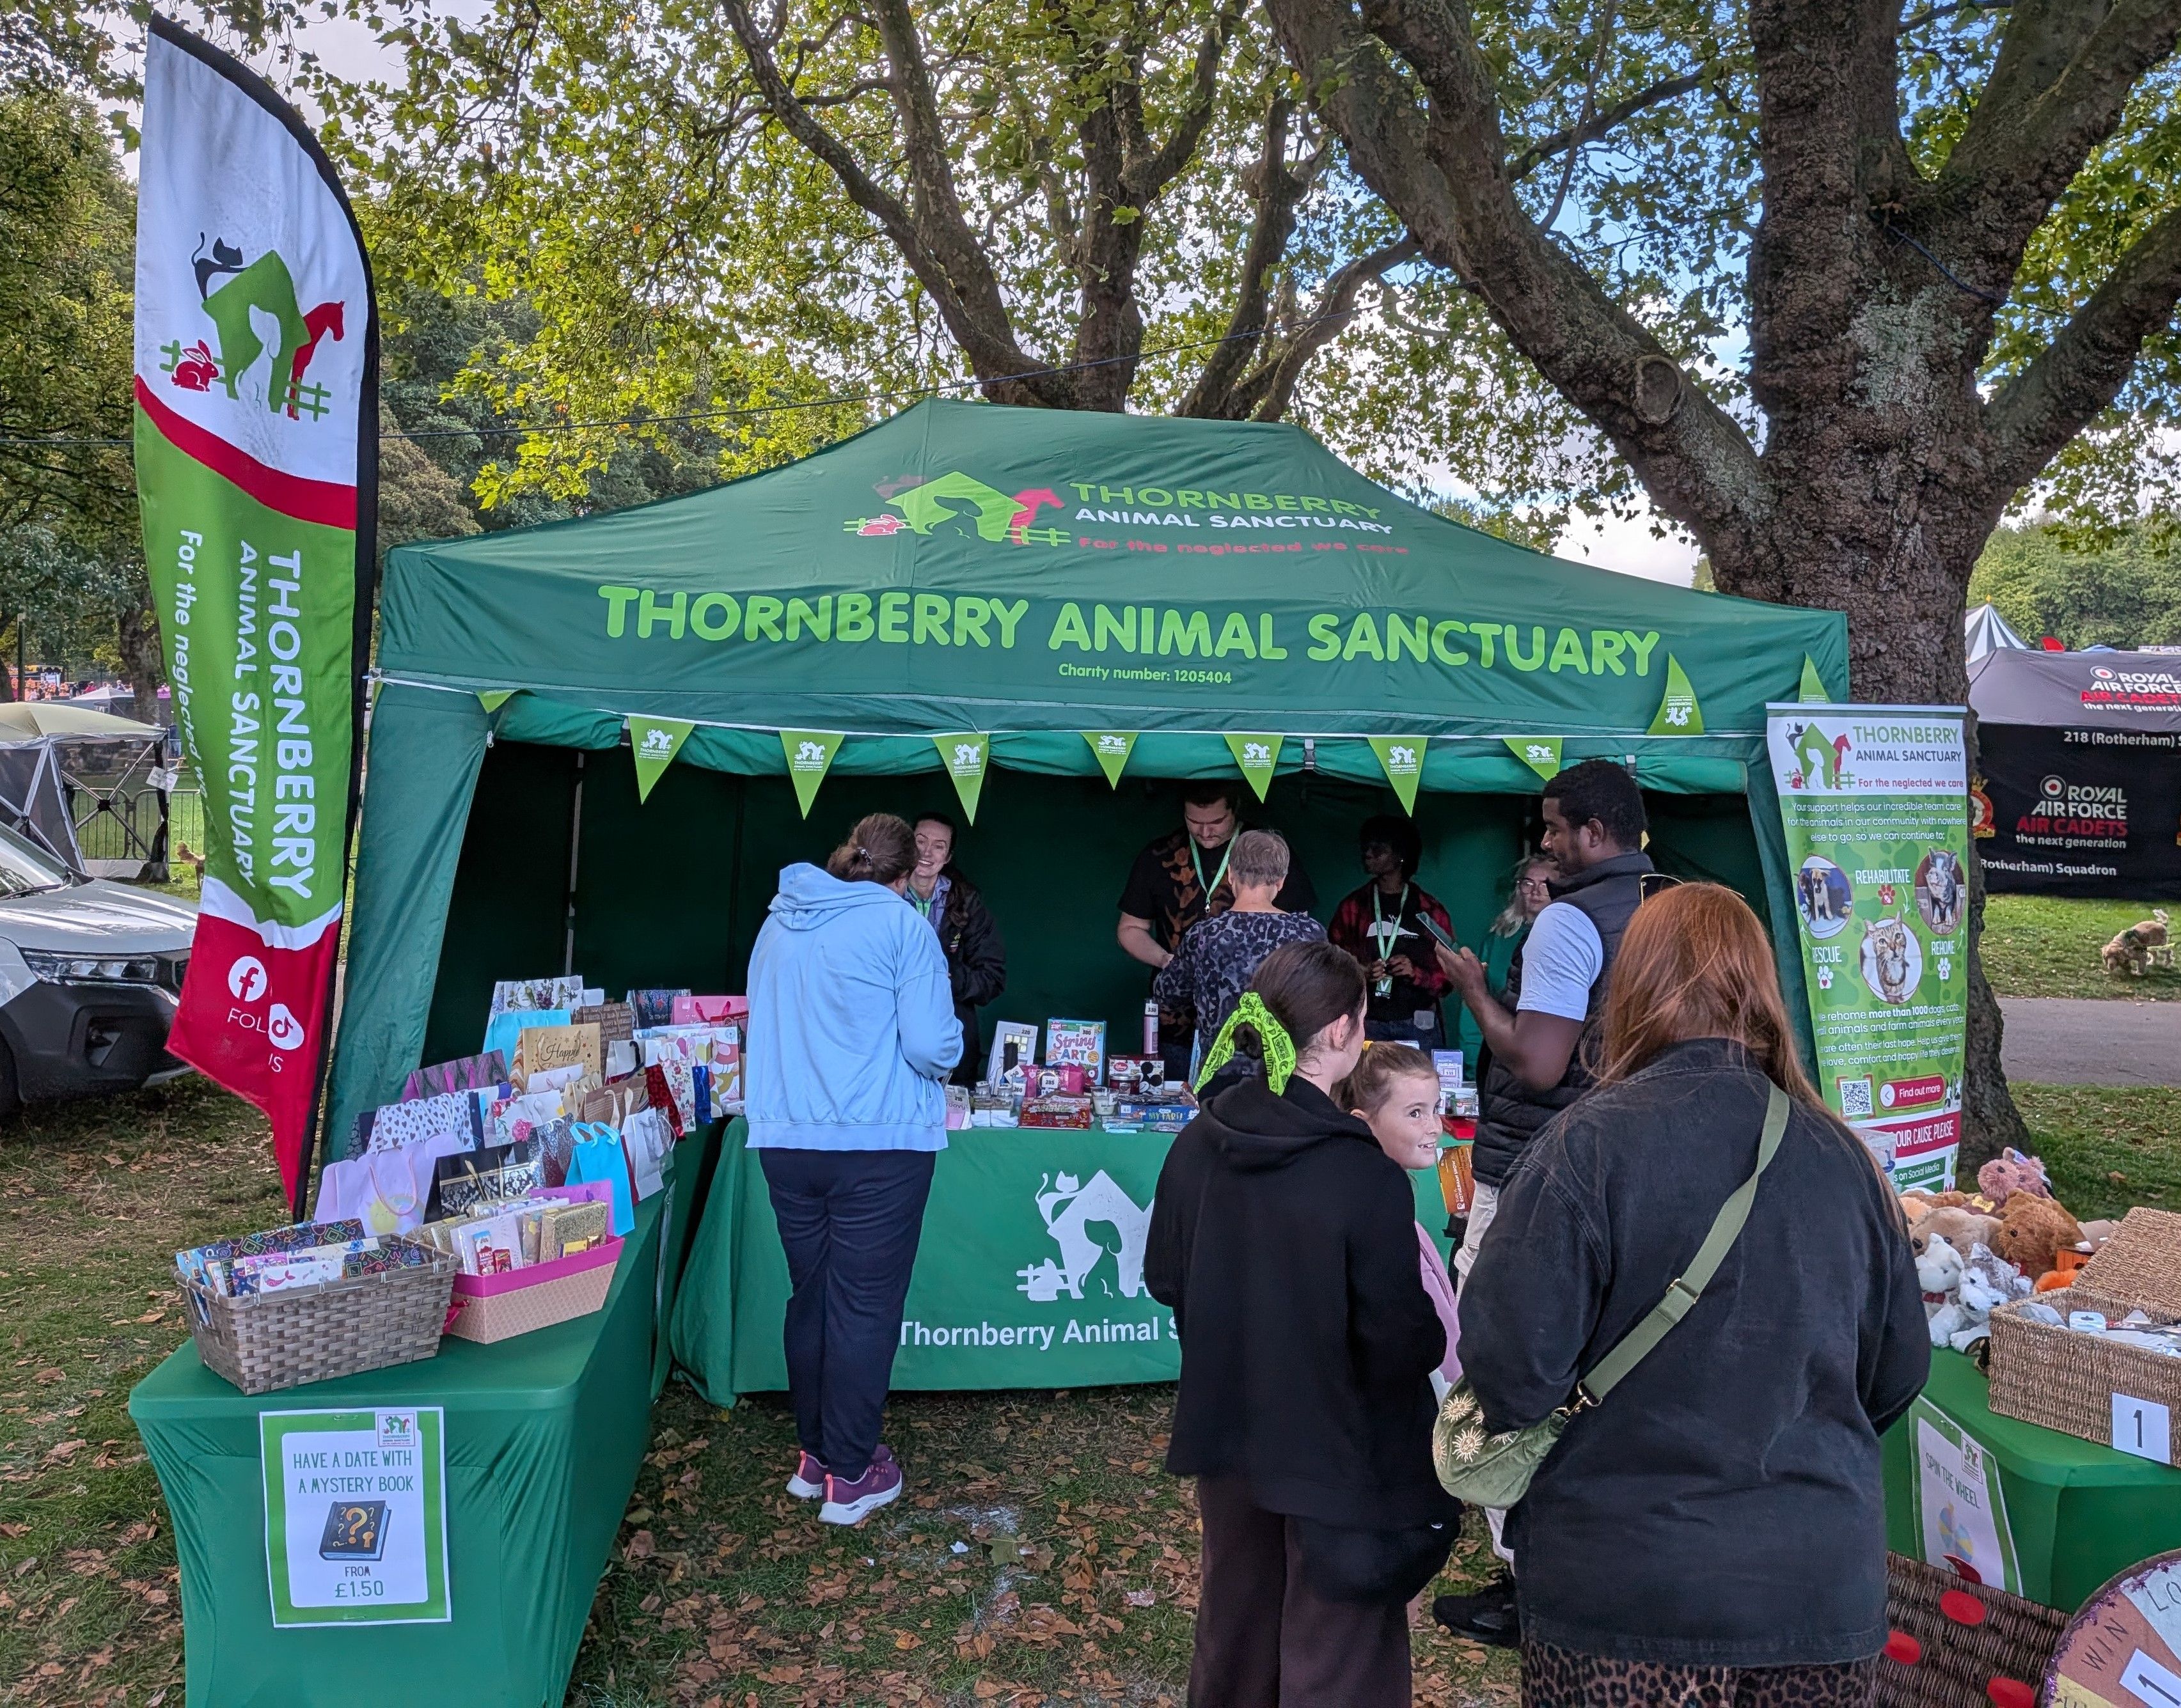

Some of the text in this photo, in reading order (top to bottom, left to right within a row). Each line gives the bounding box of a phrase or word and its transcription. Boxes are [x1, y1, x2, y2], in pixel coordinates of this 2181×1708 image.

[1070, 482, 1381, 519] THORNBERRY
[1075, 508, 1393, 534] ANIMAL SANCTUARY
[178, 529, 203, 570] For
[1079, 537, 1408, 555] For the neglected we care
[174, 581, 197, 625] the
[597, 586, 1660, 677] THORNBERRY ANIMAL SANCTUARY
[1059, 663, 1232, 684] Charity number: 1205404
[2118, 672, 2180, 684] ROYAL
[2090, 680, 2181, 694] AIR FORCE
[171, 632, 203, 762] neglected
[2081, 691, 2113, 703] AIR
[228, 540, 260, 888] ANIMAL SANCTUARY
[268, 550, 315, 898] THORNBERRY
[1852, 726, 1958, 744] THORNBERRY
[2063, 732, 2089, 742] 218
[2091, 732, 2175, 748] (Rotherham)
[1855, 750, 1962, 762] ANIMAL SANCTUARY
[1859, 778, 1872, 787] For
[1875, 778, 1889, 787] the
[1892, 778, 1932, 789] neglected
[2067, 785, 2128, 803] ROYAL
[1807, 804, 1839, 813] support
[1841, 803, 1865, 813] helps
[1883, 802, 1923, 811] incredible
[2031, 801, 2127, 820] AIR FORCE
[1787, 817, 1800, 826] for
[1810, 817, 1843, 827] animals
[1872, 817, 1919, 827] community
[1937, 817, 1966, 826] nowhere
[2016, 816, 2128, 837] AIR CADETS
[1840, 834, 1854, 844] go,
[1901, 832, 1934, 840] continue
[2015, 834, 2127, 849] the next generation
[1855, 869, 1910, 884] REHABILITATE
[2056, 863, 2117, 876] Squadron
[1811, 946, 1842, 964] RESCUE
[1931, 940, 1955, 955] REHOME
[1827, 1012, 1866, 1021] rehome
[1868, 1009, 1891, 1019] more
[1893, 1007, 1911, 1017] than
[1912, 1005, 1928, 1015] 1000
[1828, 1024, 1868, 1035] animals
[1870, 1022, 1886, 1032] and
[1887, 1021, 1907, 1031] farm
[1909, 1019, 1935, 1030] animals
[540, 1043, 580, 1062] Happy
[1838, 1042, 1862, 1052] often
[1864, 1040, 1882, 1050] their
[1883, 1039, 1896, 1049] last
[1061, 1049, 1087, 1061] ART
[1848, 1054, 1882, 1065] comfort
[1883, 1053, 1896, 1062] and
[1898, 1051, 1918, 1063] happy
[1899, 1086, 1915, 1099] Find
[1916, 1086, 1928, 1096] out
[1913, 1125, 1933, 1145] CAUSE
[1933, 1120, 1954, 1140] PLEASE
[1908, 1166, 1925, 1179] Social
[1925, 1163, 1940, 1175] Media
[901, 1321, 1055, 1351] Thornberry
[1062, 1316, 1159, 1344] Animal
[2132, 1409, 2143, 1449] 1
[293, 1450, 412, 1469] HAVE A DATE WITH
[298, 1475, 414, 1494] A MYSTERY BOOK
[1925, 1452, 1941, 1478] SPIN
[1941, 1466, 1954, 1491] THE
[1955, 1477, 1980, 1510] WHEEL
[345, 1565, 370, 1577] FROM
[335, 1580, 384, 1598] £1.50
[2081, 1617, 2129, 1672] WIN
